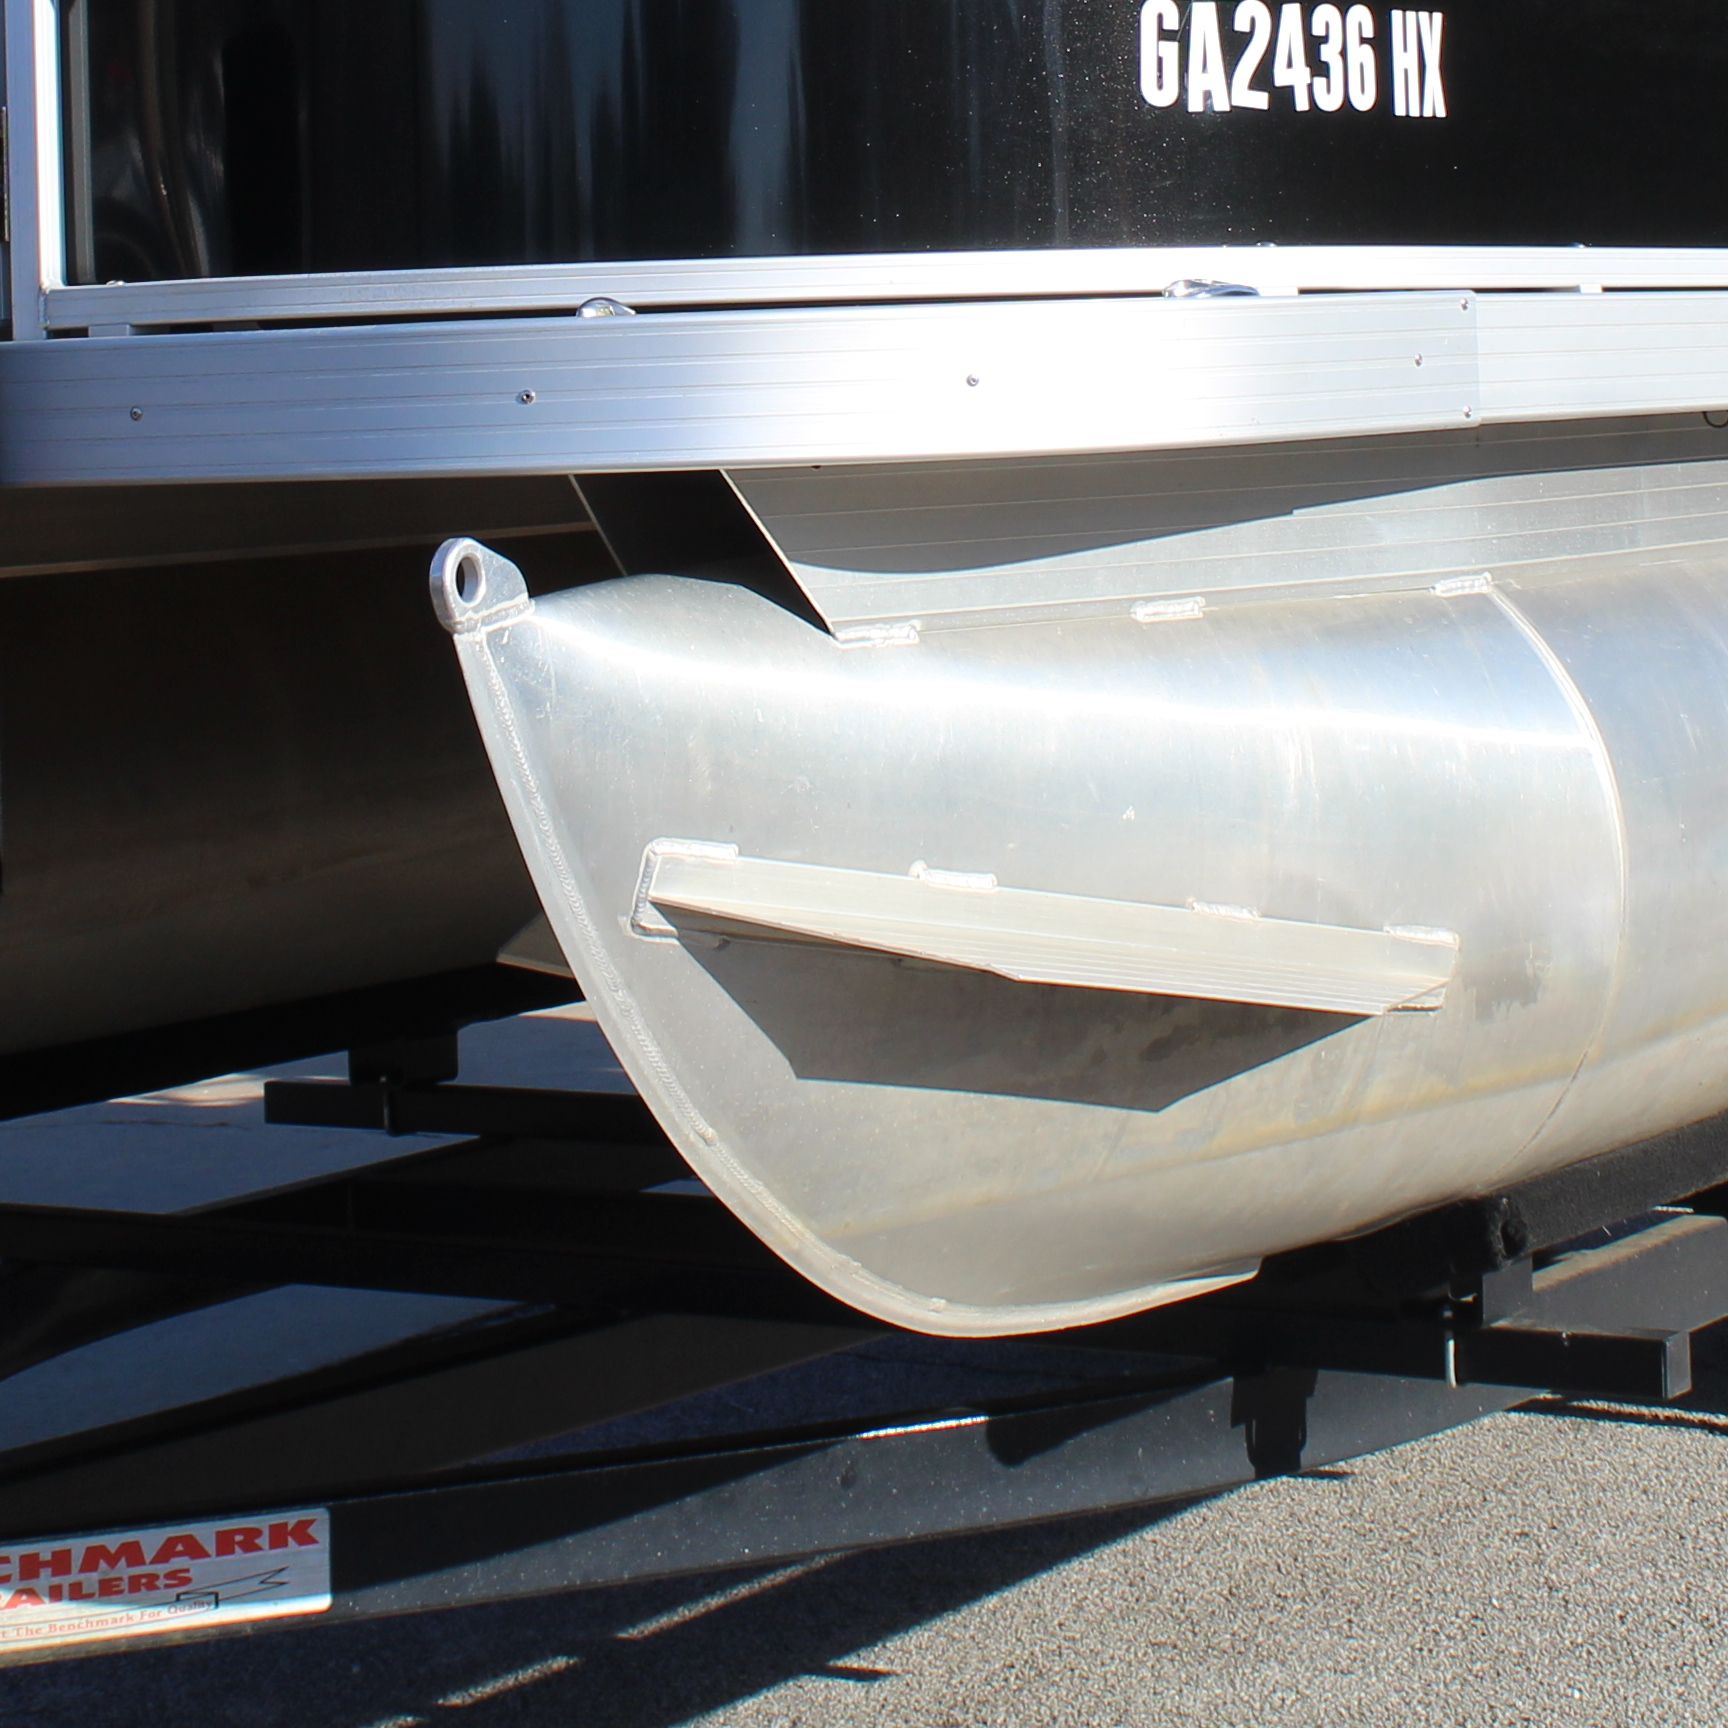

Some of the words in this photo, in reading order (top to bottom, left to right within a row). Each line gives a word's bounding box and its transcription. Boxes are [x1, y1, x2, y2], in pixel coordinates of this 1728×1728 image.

[1388, 8, 1448, 119] HX
[15, 1625, 43, 1638] The
[48, 1613, 134, 1634] Benchmark
[140, 1610, 163, 1622] For
